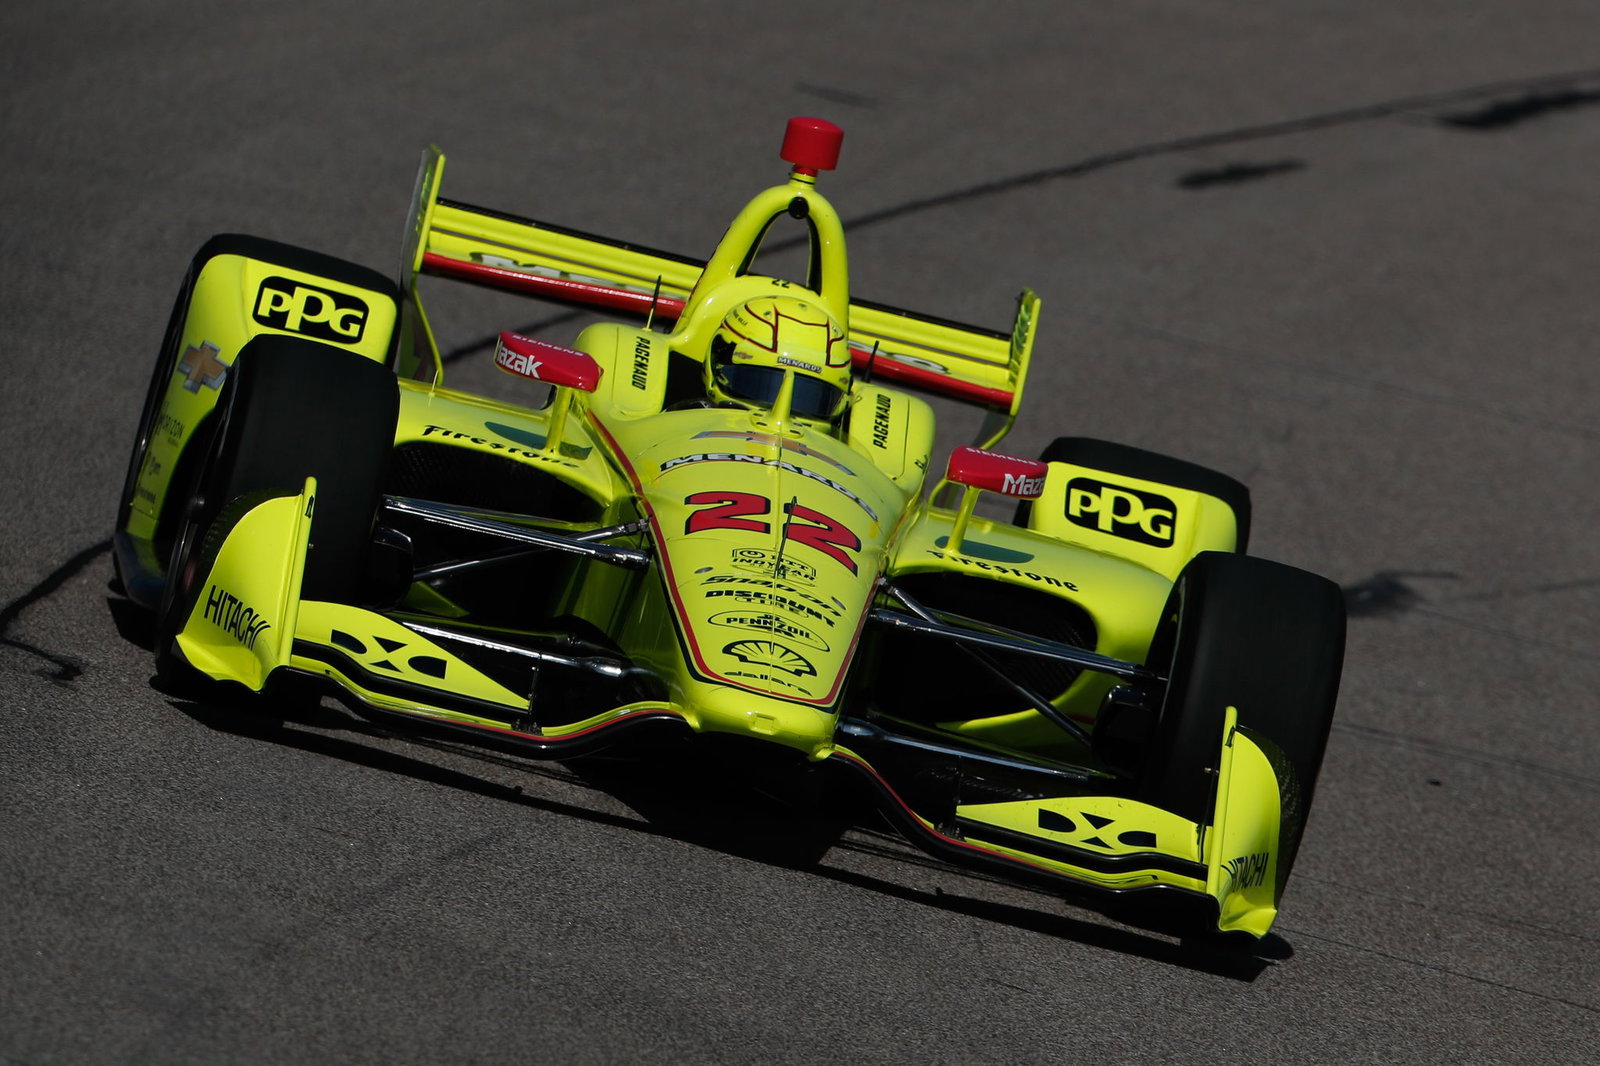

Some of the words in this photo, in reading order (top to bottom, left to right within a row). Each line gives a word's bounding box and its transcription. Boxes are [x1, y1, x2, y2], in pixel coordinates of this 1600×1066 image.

[257, 286, 364, 338] PPG
[512, 334, 584, 357] SIEMENS
[631, 336, 650, 391] PAGENAUD
[873, 394, 891, 449] PAGENAUD
[422, 424, 579, 468] Firestone
[965, 447, 1038, 466] SIEMENS
[684, 491, 862, 577] 22
[1069, 486, 1173, 540] PPG
[926, 550, 1079, 593] Firestone
[204, 585, 271, 650] HITACHI
[705, 590, 835, 628] DISCOUNT
[726, 617, 811, 639] PENNZOIL
[1220, 852, 1269, 892] HITACHI
